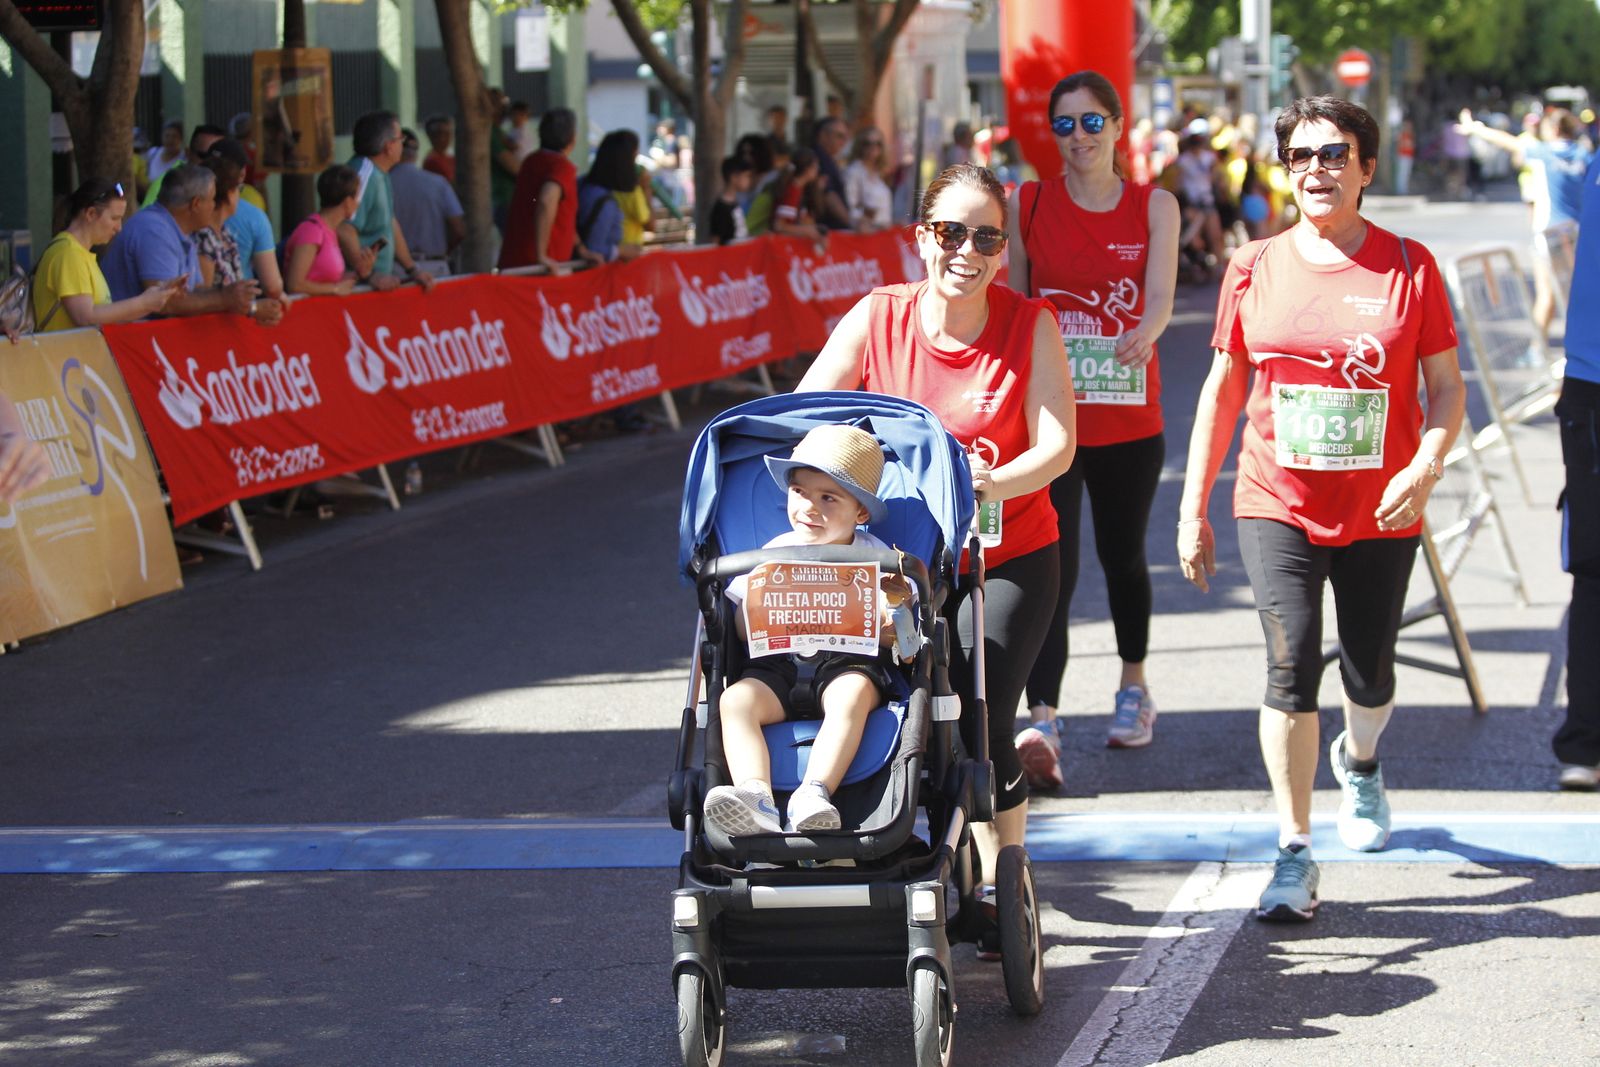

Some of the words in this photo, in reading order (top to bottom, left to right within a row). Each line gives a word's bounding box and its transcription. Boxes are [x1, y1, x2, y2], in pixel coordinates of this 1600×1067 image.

[375, 310, 511, 389] Santander
[1068, 357, 1131, 379] 1043
[187, 344, 321, 425] Santander
[1085, 379, 1100, 390] JOSÉ
[1101, 381, 1107, 389] Y
[1107, 381, 1131, 390] MARTA
[1286, 413, 1365, 441] 1031
[1308, 442, 1354, 454] MERCEDES
[791, 567, 838, 575] CARRERA
[791, 573, 838, 581] SOLIDARIA
[763, 592, 810, 608] ATLETA
[813, 592, 846, 608] POCO
[768, 610, 842, 625] FRECUENTE
[785, 624, 832, 635] MARIO
